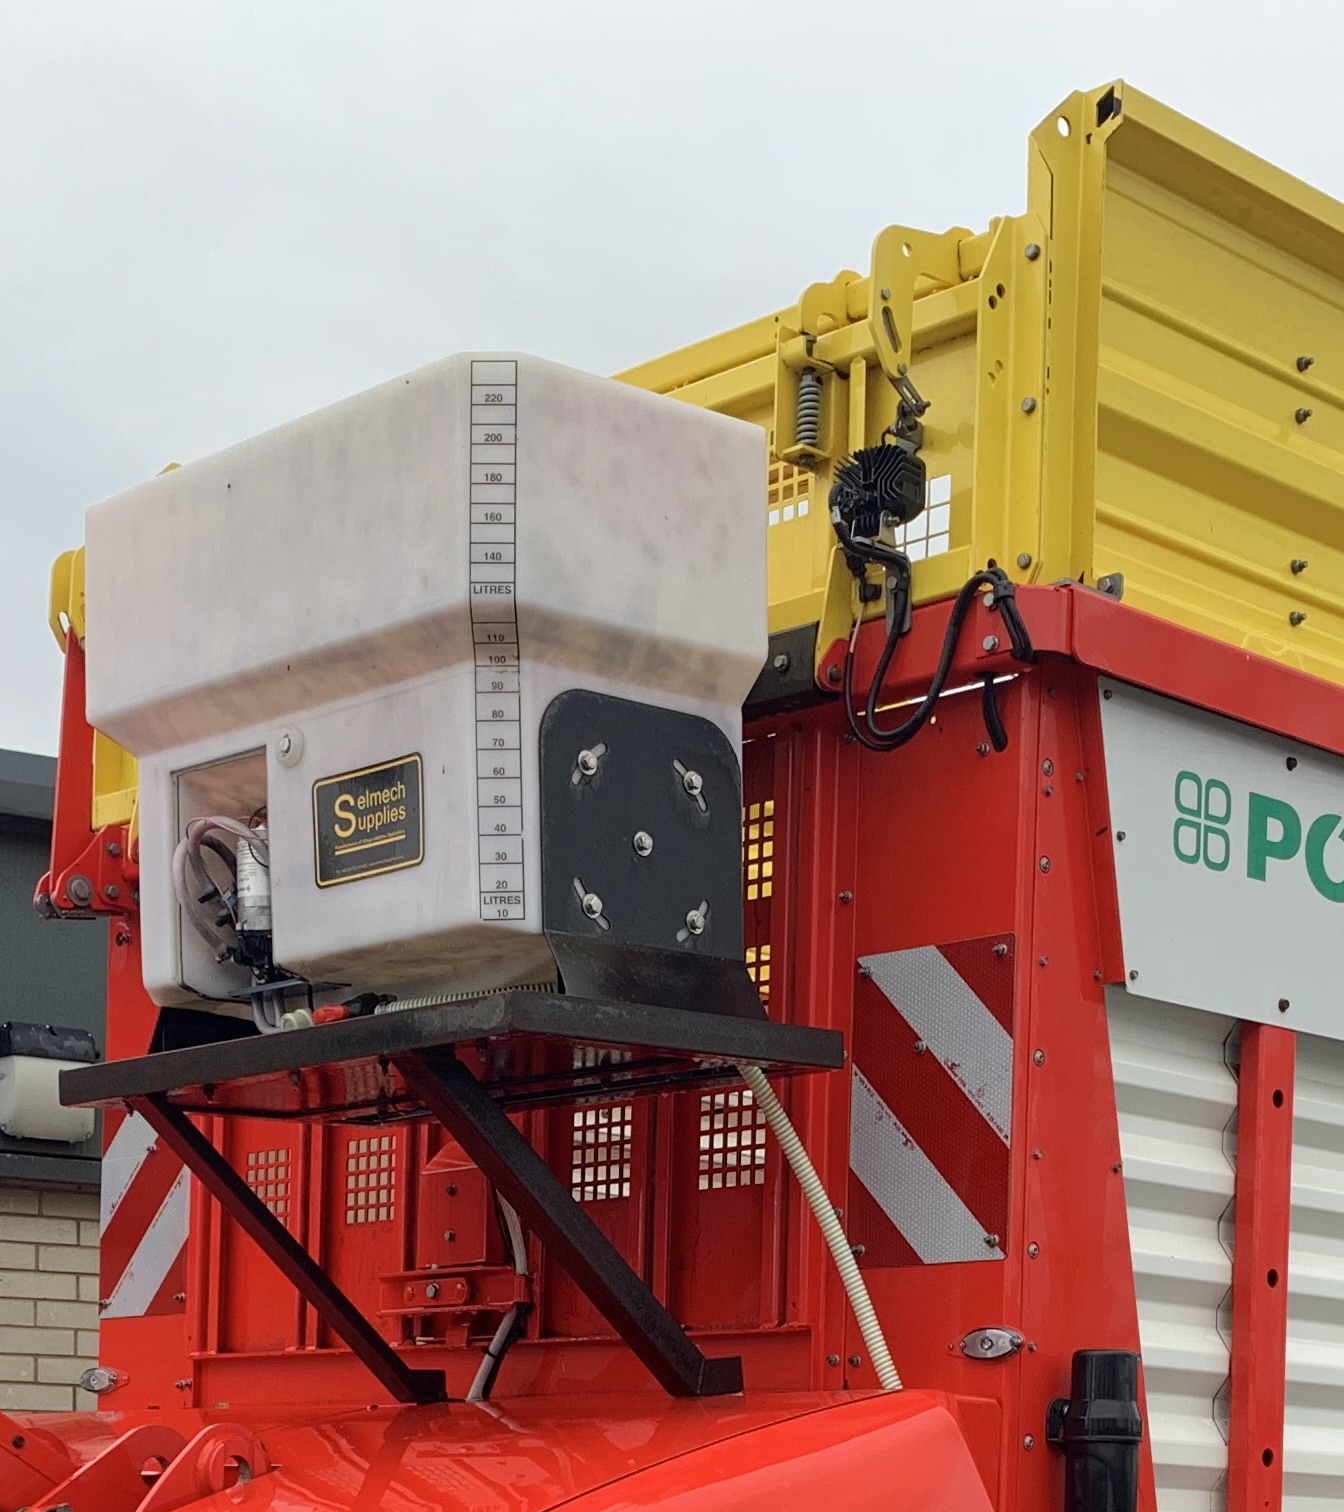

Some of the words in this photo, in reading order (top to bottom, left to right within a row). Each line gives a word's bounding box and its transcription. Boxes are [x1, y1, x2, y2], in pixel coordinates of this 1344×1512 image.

[484, 394, 503, 402] 220
[484, 433, 502, 442] 200
[484, 473, 502, 482] 180
[484, 512, 502, 521] 160
[484, 552, 502, 561] 140
[473, 585, 512, 595] LITRES
[486, 634, 505, 642] 110
[488, 655, 506, 664] 100
[491, 681, 504, 690] 90
[491, 710, 504, 719] 80
[492, 738, 505, 747] 70
[492, 767, 505, 776] 60
[493, 795, 506, 804] 50
[494, 823, 507, 833] 40
[494, 852, 507, 861] 30
[495, 880, 508, 889] 20
[483, 896, 521, 905] LITRES
[497, 909, 509, 918] 10
